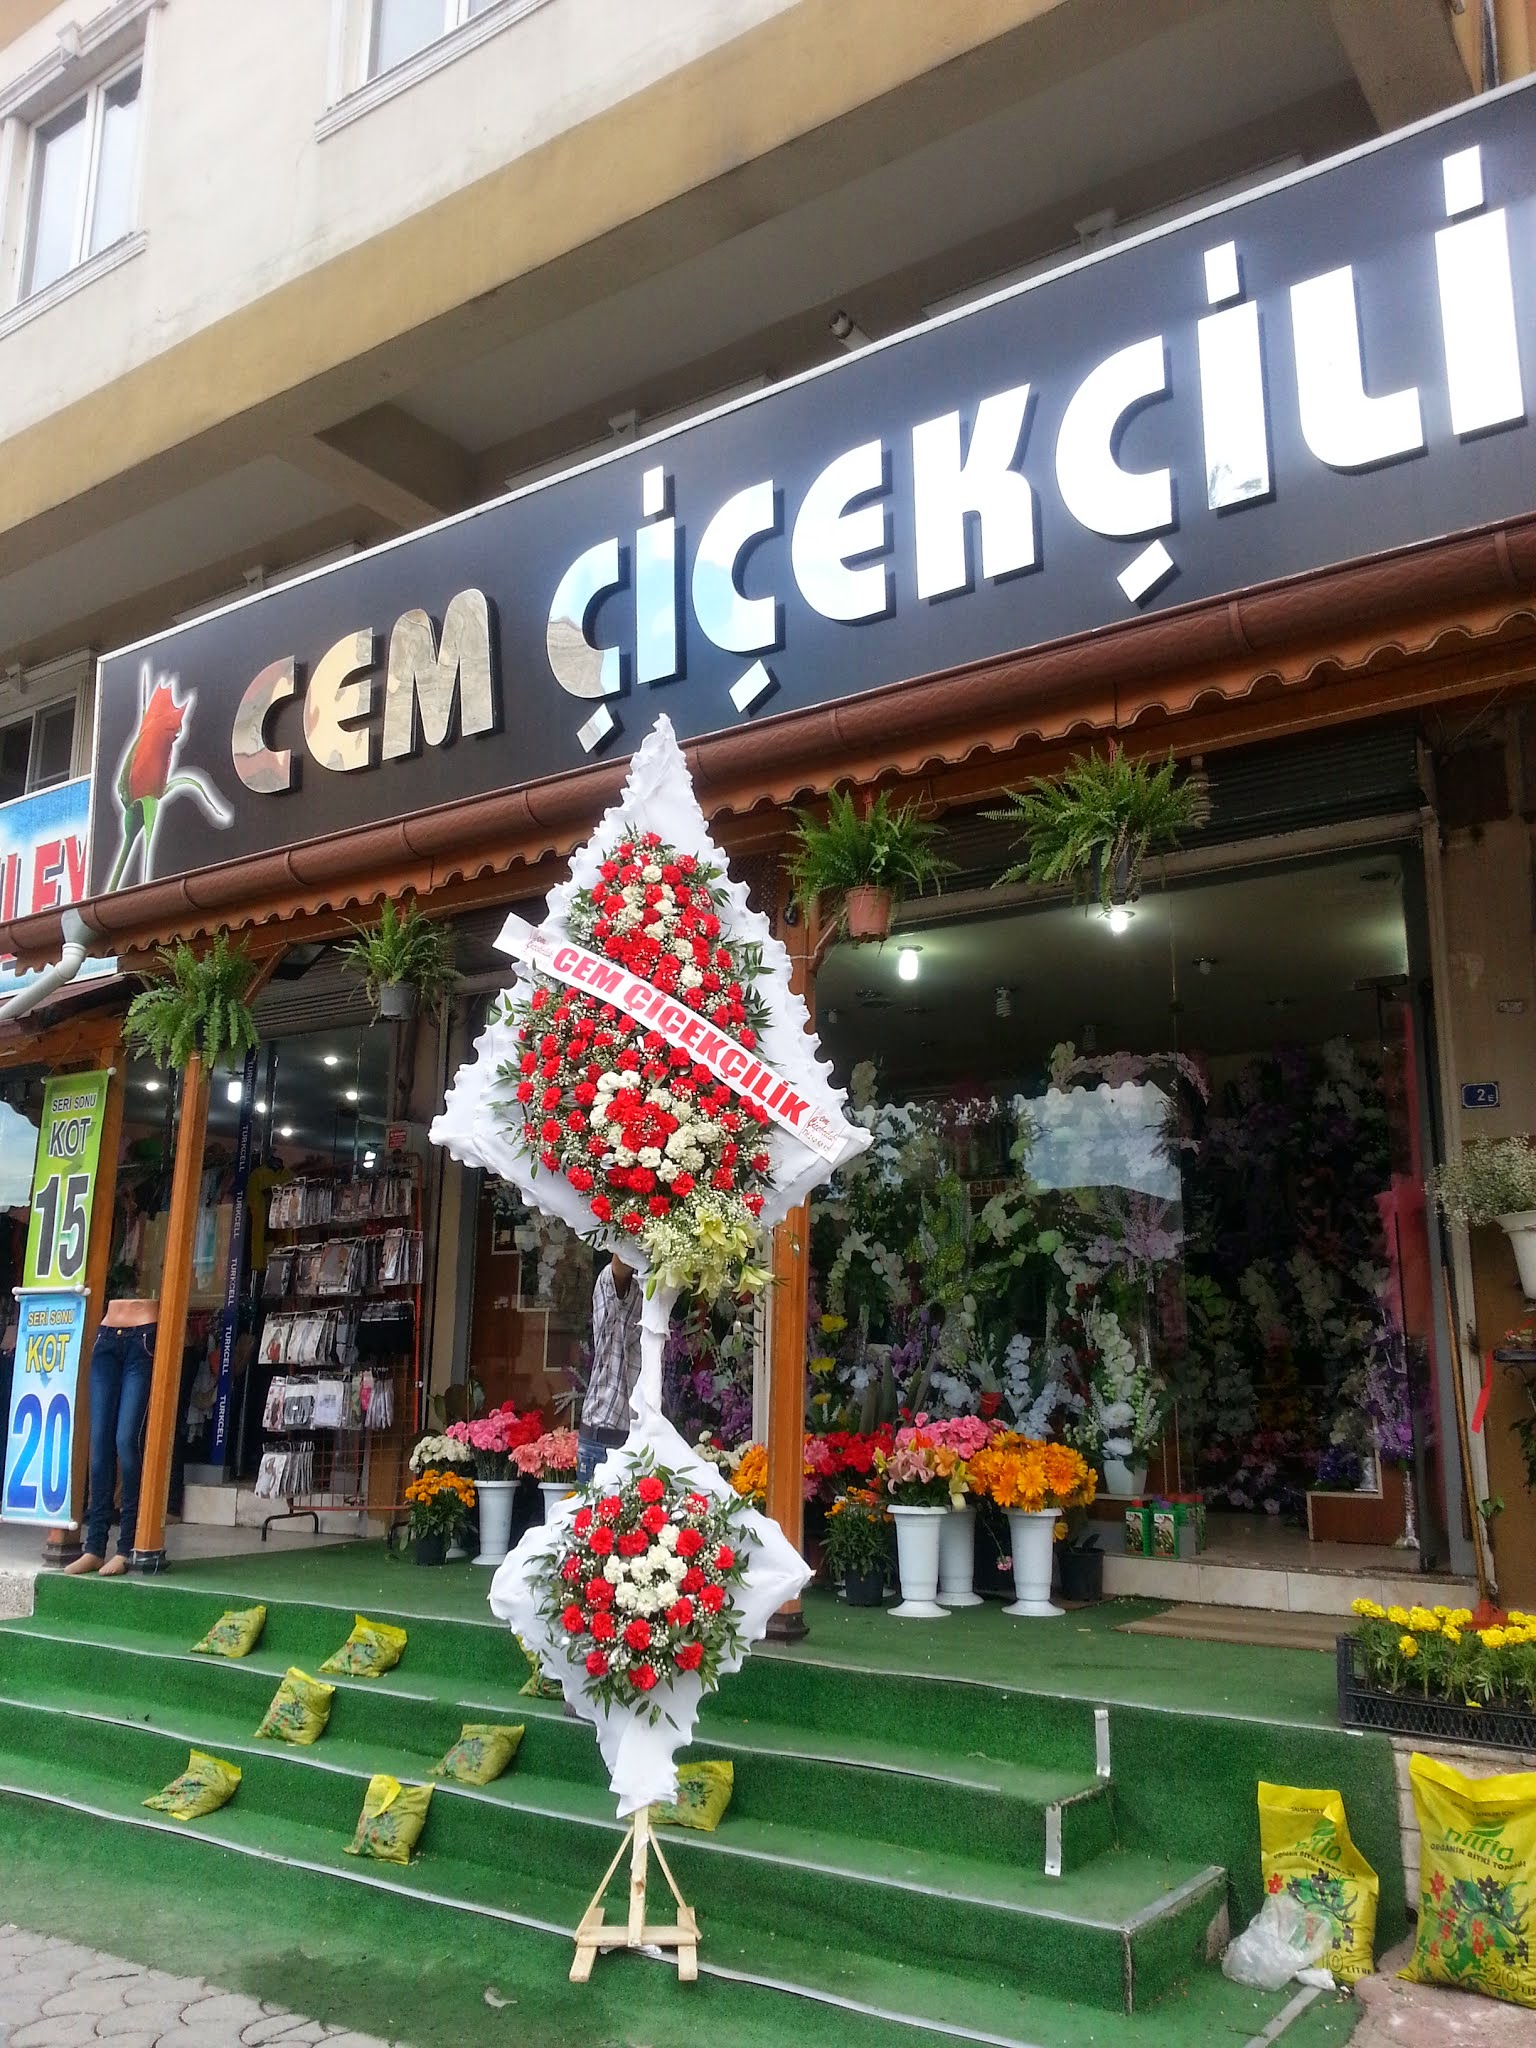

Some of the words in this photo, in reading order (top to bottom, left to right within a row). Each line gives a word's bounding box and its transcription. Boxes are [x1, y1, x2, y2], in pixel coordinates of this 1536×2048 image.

[231, 588, 495, 794] CEM
[553, 947, 625, 994] CEM
[622, 981, 811, 1127] ÇİÇEKÇİLİK
[52, 1095, 72, 1112] SERİ
[74, 1093, 97, 1109] SONU
[244, 1061, 255, 1106] TURKCELL
[50, 1117, 92, 1157] KOT
[238, 1124, 249, 1173] TURKCELL
[34, 1174, 91, 1280] 15
[233, 1190, 244, 1240] TURKCELL
[227, 1257, 238, 1307] TURKCELL
[27, 1307, 48, 1326] SERİ
[50, 1308, 75, 1325] SONU
[25, 1333, 70, 1373] KOT
[222, 1325, 233, 1376] TURKCELL
[216, 1394, 227, 1446] TURKCELL
[7, 1393, 71, 1513] 20
